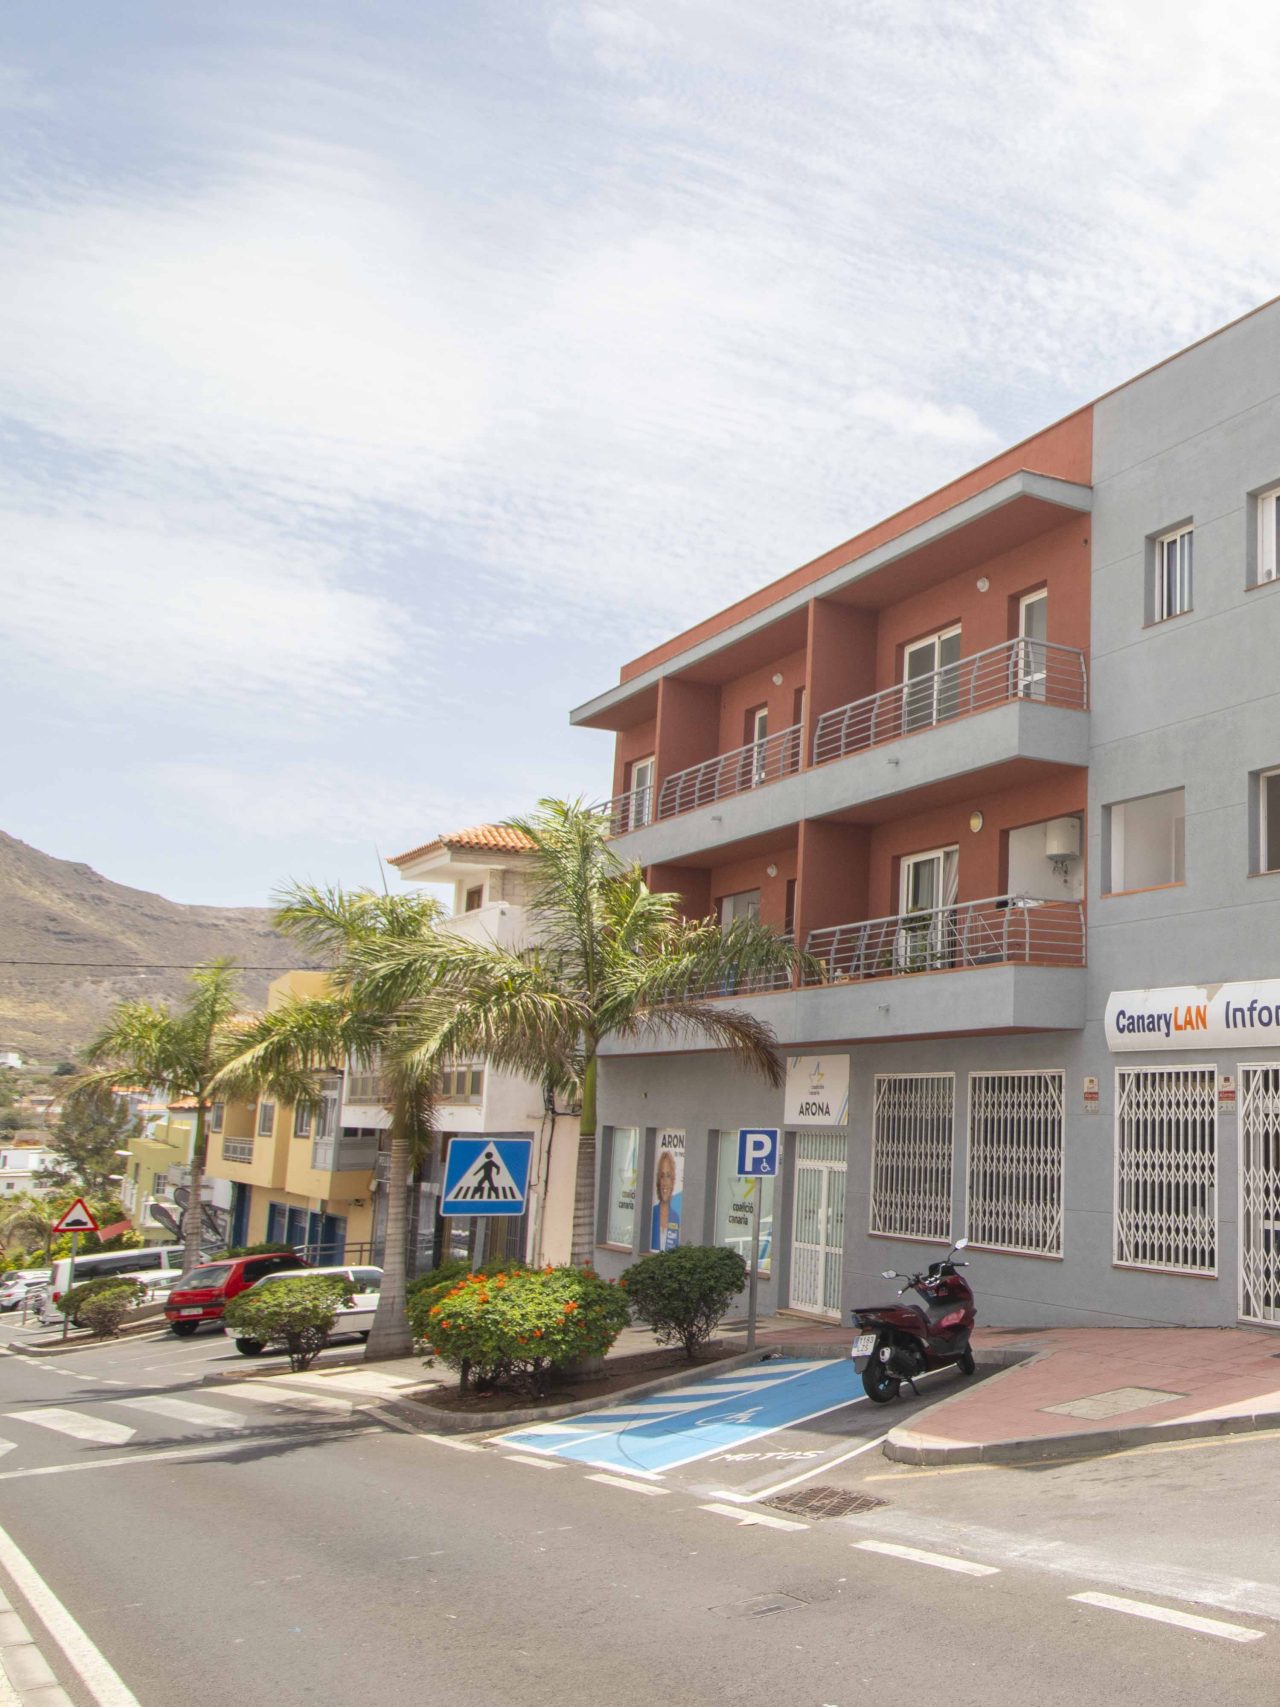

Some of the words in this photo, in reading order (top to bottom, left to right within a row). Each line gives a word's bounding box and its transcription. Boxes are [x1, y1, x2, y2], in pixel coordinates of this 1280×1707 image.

[1115, 1004, 1208, 1038] CanaryLAN
[799, 1101, 831, 1117] ARONA
[661, 1134, 685, 1149] ARON
[744, 1133, 773, 1172] P
[708, 1450, 825, 1462] MOTOS
